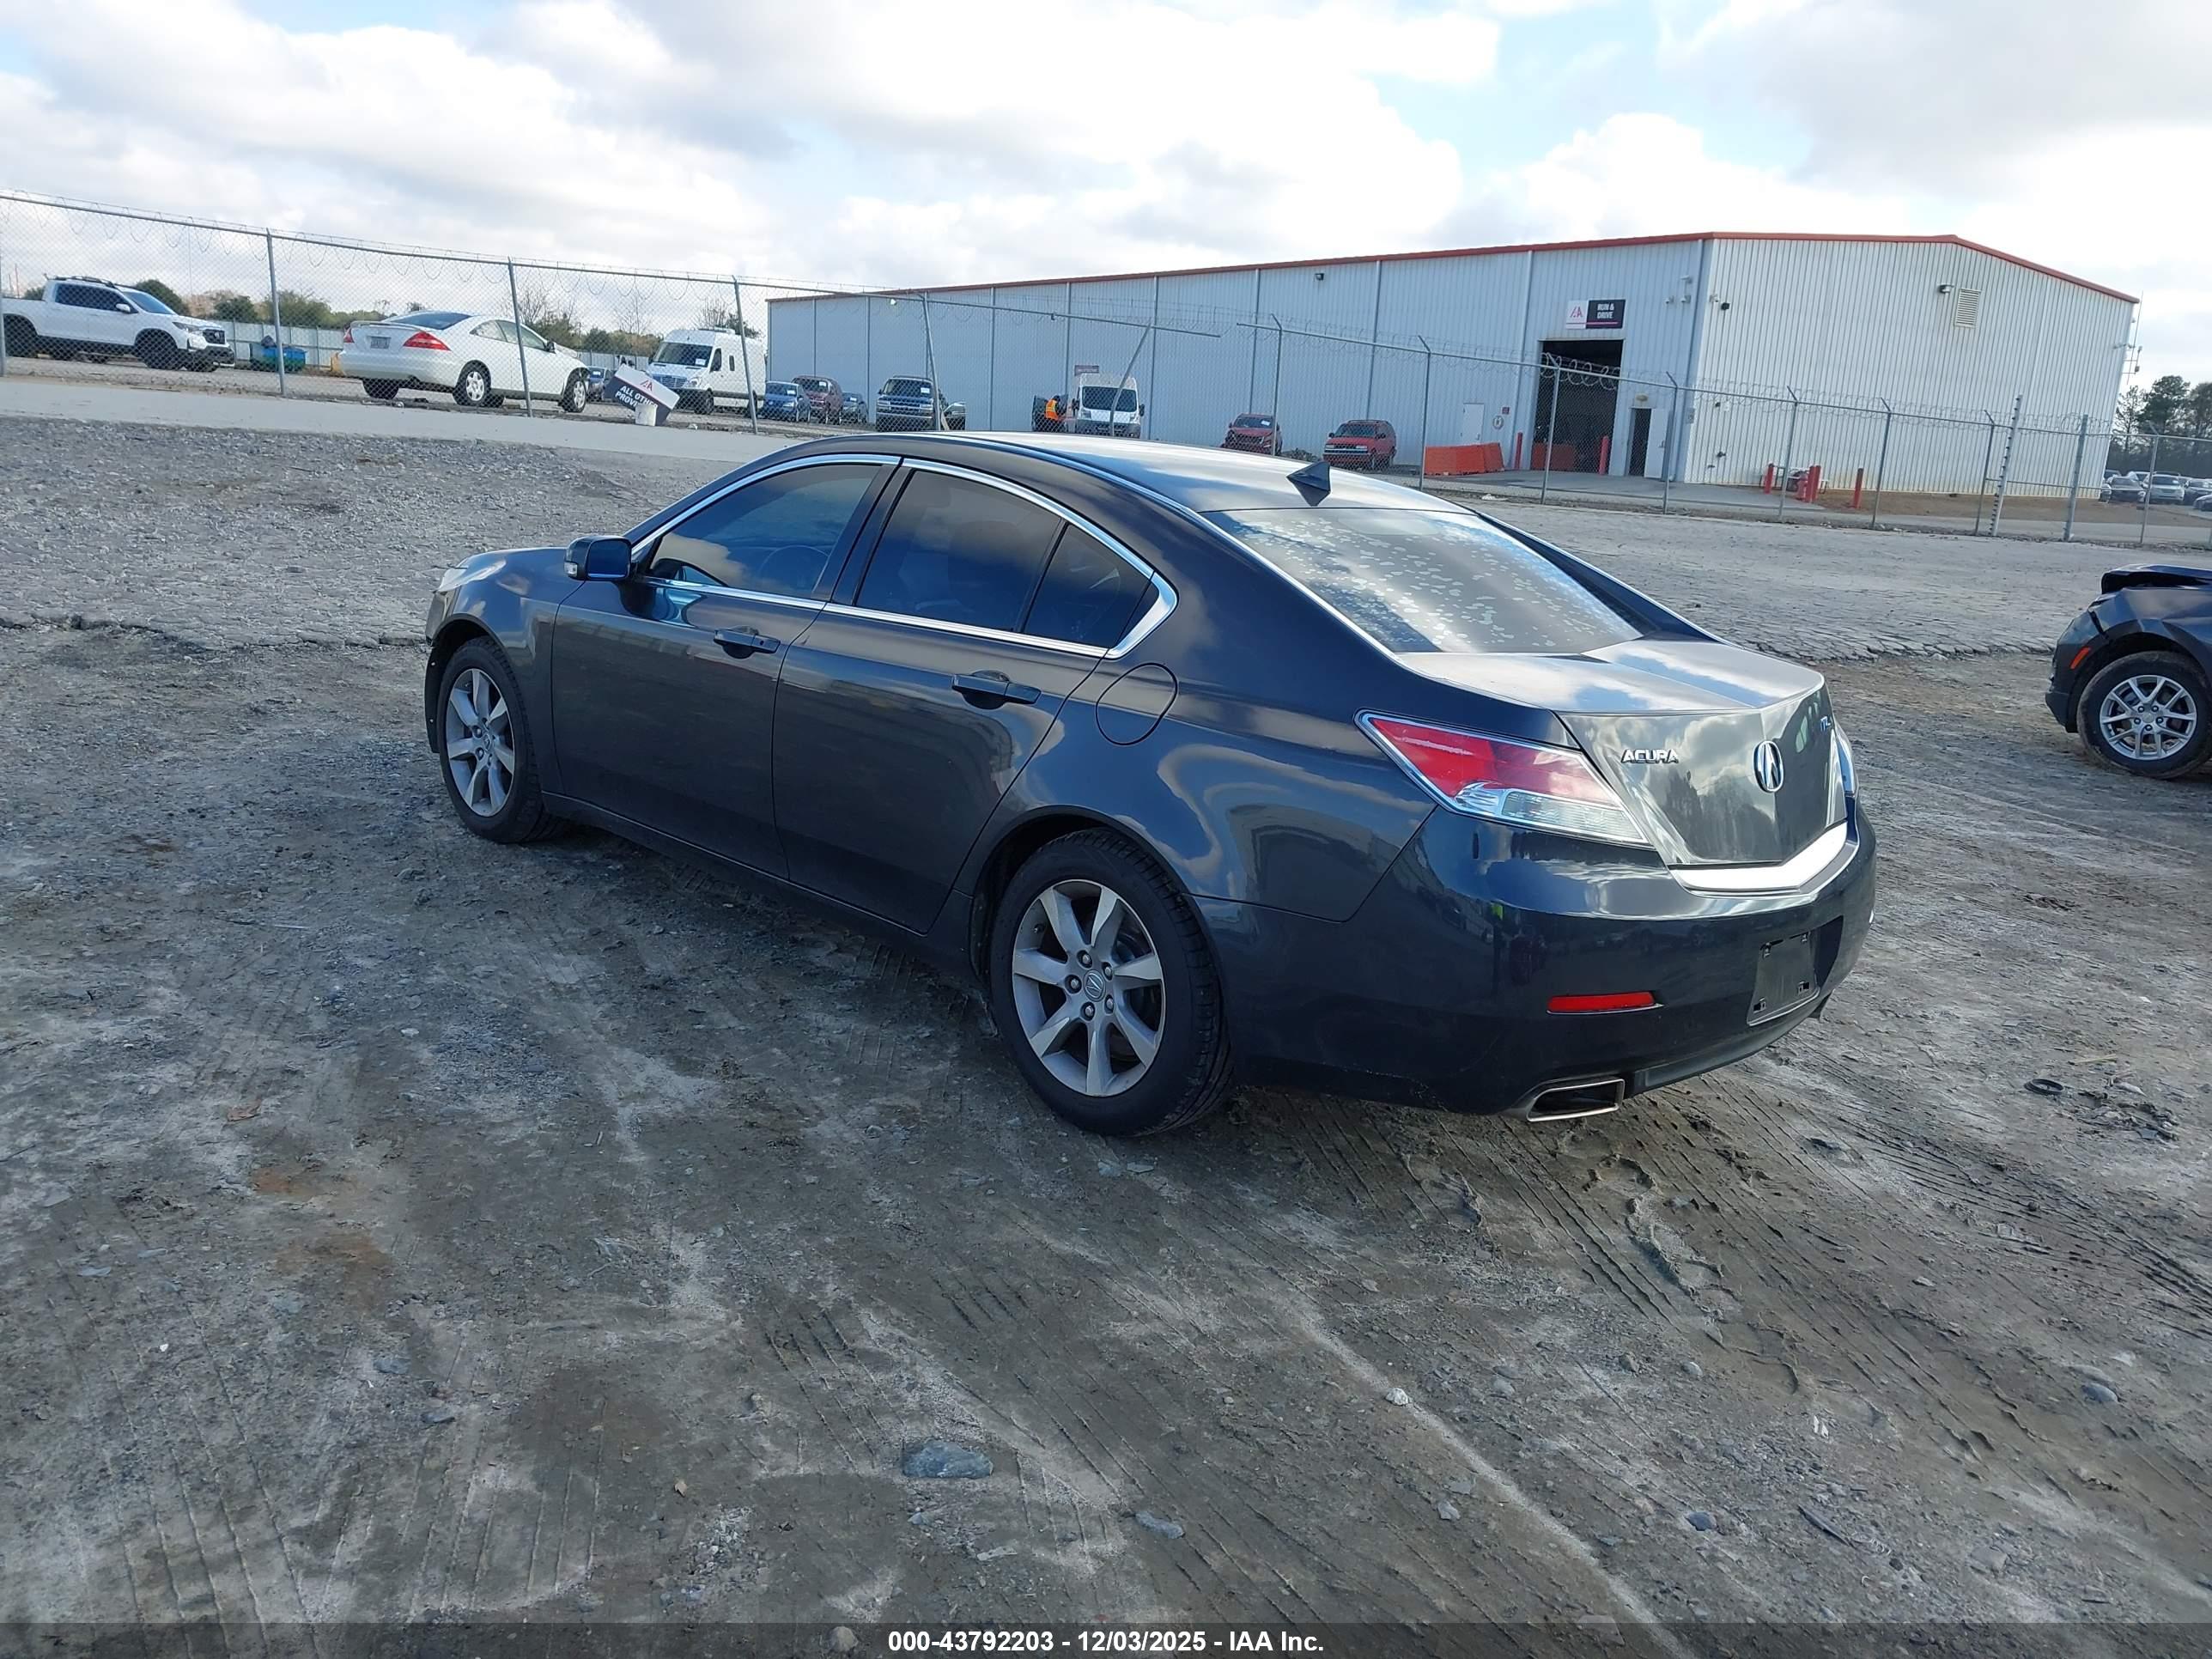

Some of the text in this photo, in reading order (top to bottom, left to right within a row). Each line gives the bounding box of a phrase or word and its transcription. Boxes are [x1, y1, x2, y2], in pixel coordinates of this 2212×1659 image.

[1597, 311, 1613, 319] DRIVE
[620, 386, 634, 397] ALL
[615, 391, 637, 407] PROVI
[1621, 749, 1679, 763] ACURA
